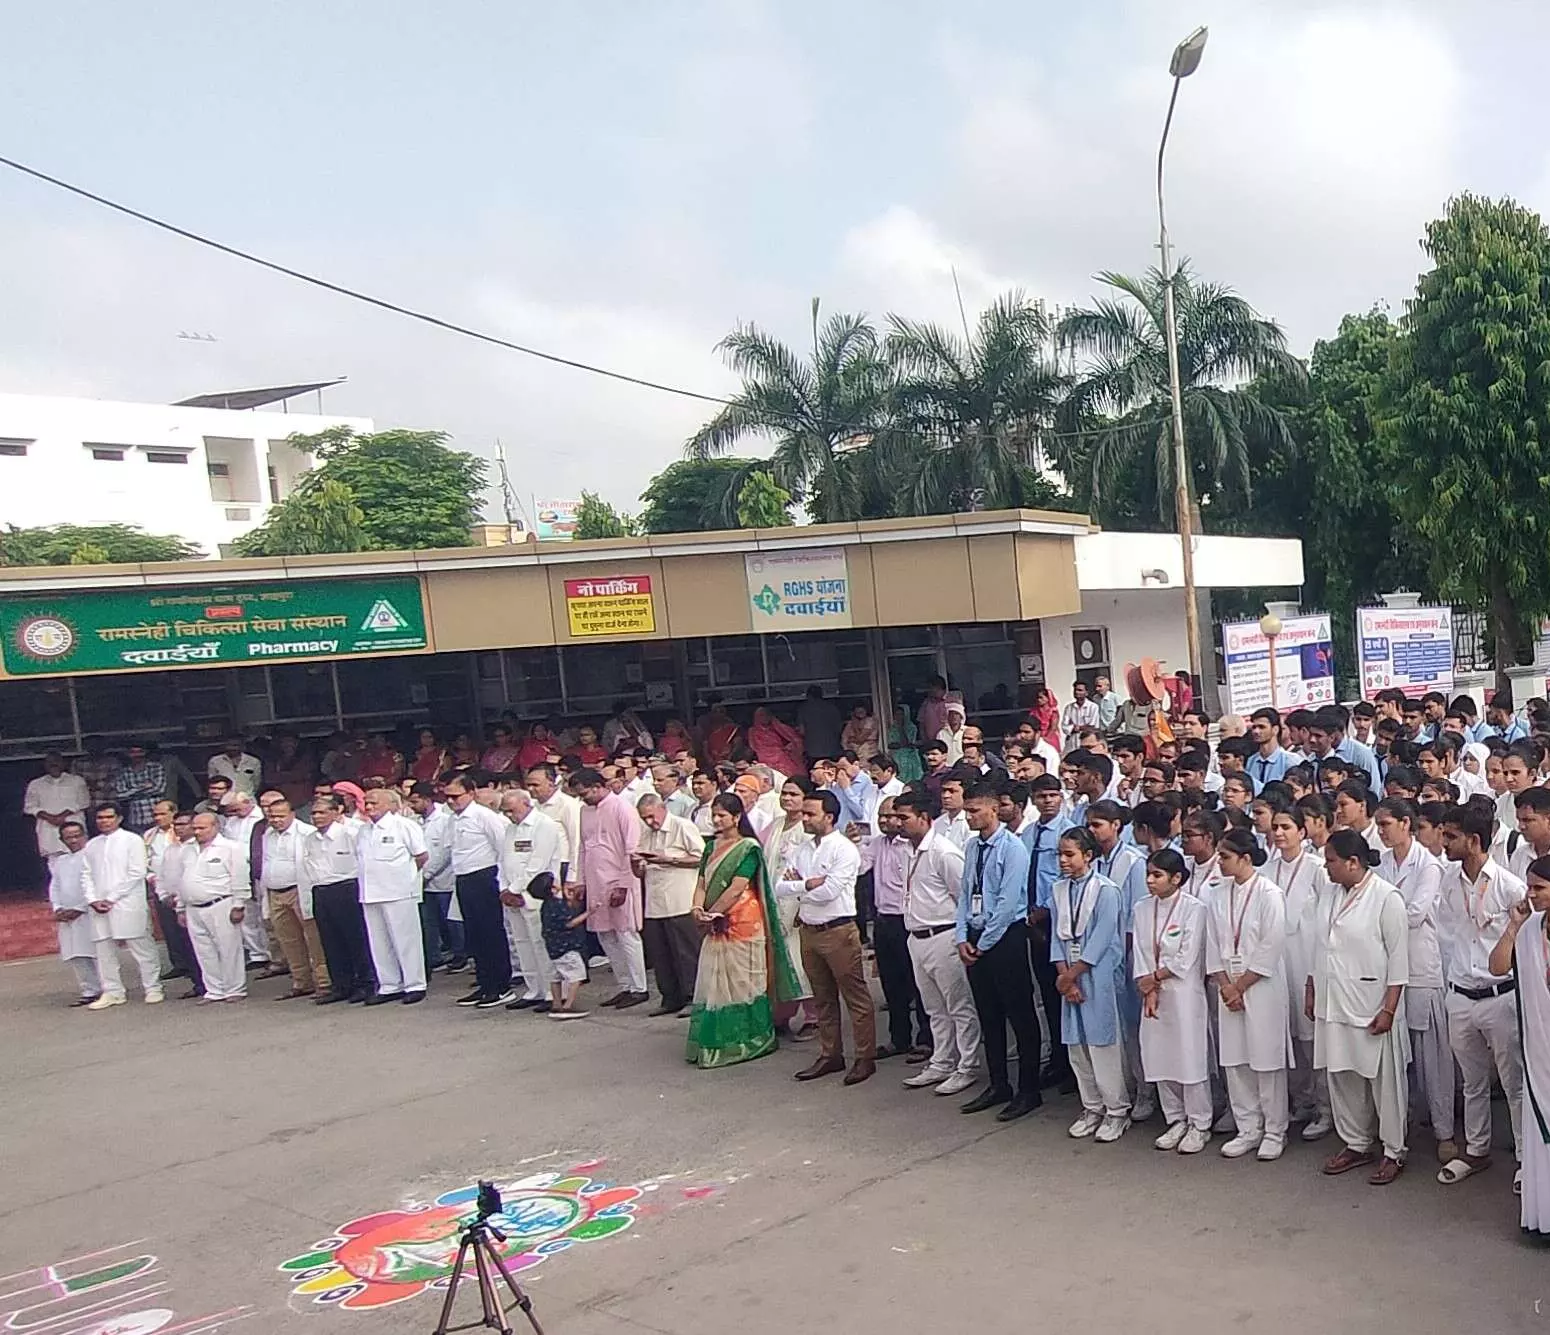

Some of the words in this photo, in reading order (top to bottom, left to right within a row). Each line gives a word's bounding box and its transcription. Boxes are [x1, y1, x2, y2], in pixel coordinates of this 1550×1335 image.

[577, 582, 594, 596] नो
[596, 580, 639, 595] पार्किंग
[784, 581, 813, 596] RGHS
[816, 576, 845, 594] योजना
[96, 621, 171, 641] रामस्नेही
[174, 619, 248, 638] चिकित्सा
[252, 616, 286, 633] सेवा
[290, 614, 347, 631] संस्थान
[249, 640, 338, 655] Pharmacy
